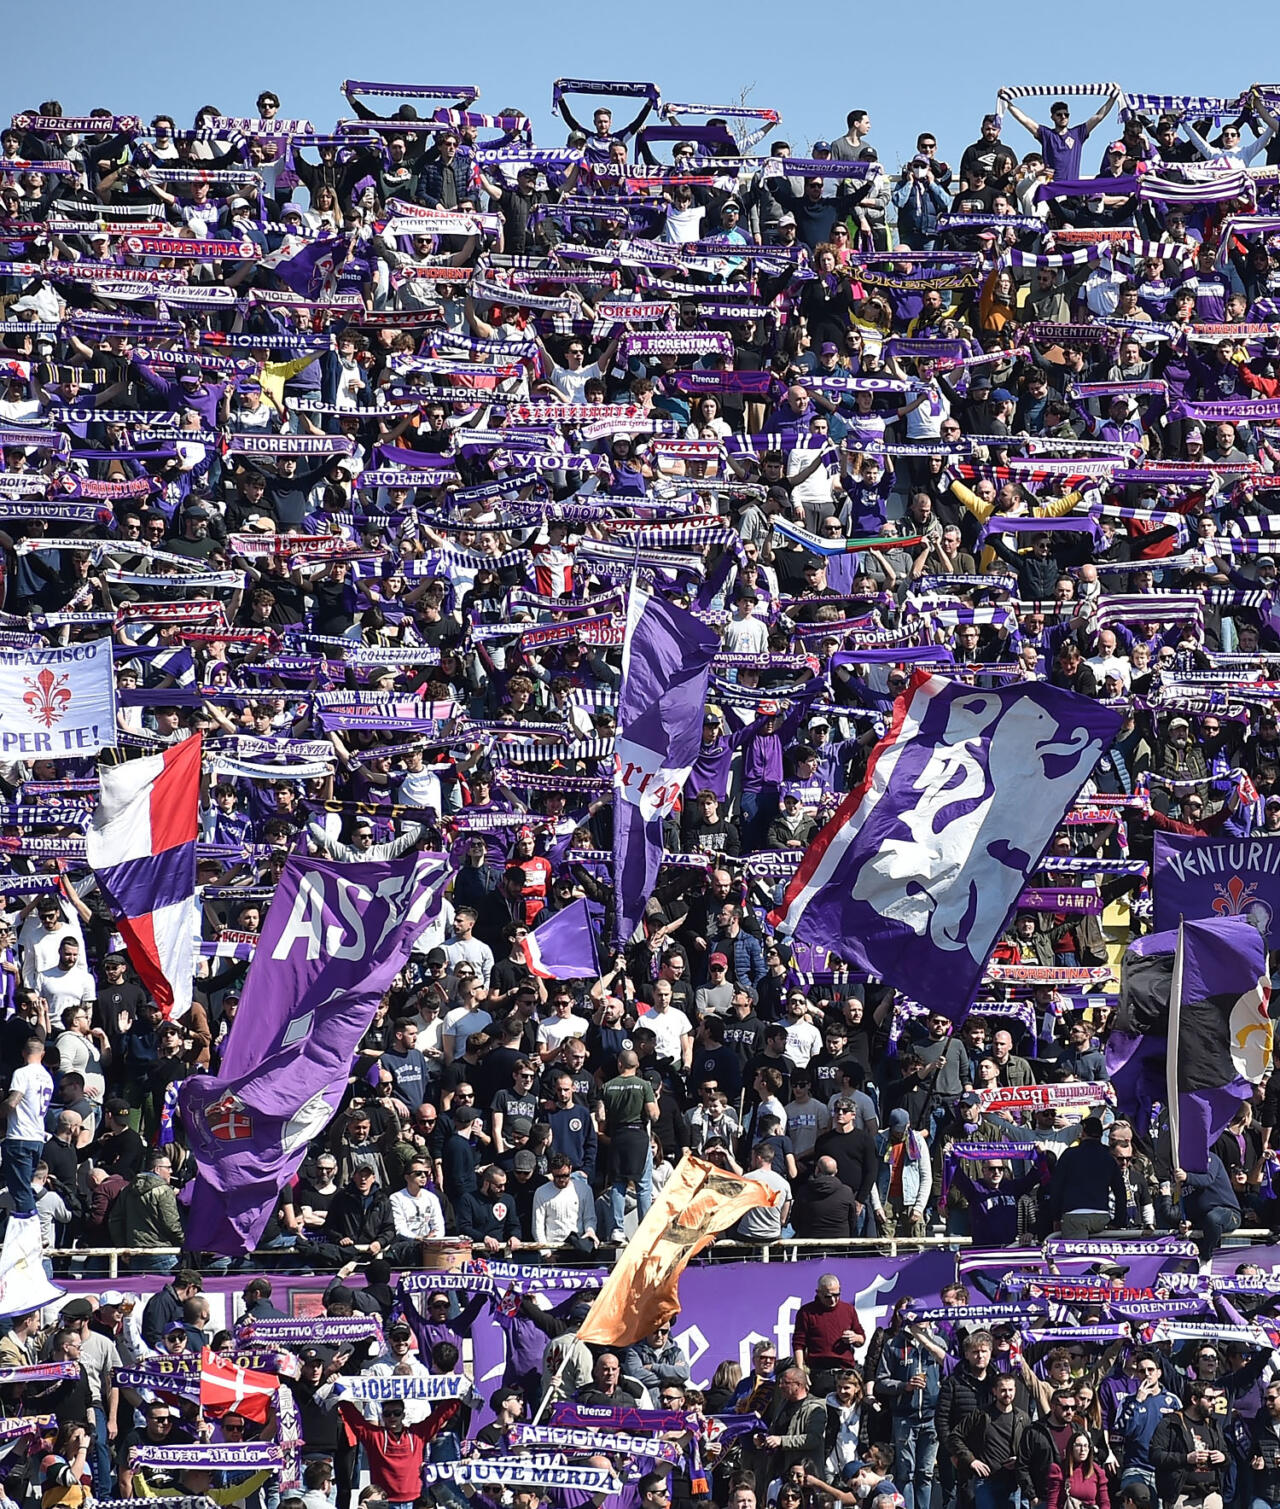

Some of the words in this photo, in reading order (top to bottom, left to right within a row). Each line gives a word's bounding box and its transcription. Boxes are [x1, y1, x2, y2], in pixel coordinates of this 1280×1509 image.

[558, 79, 648, 93] FIORENTINA
[1127, 92, 1220, 111] ULTRAS
[35, 116, 113, 130] FIORENTINA
[475, 147, 583, 164] COLLETTIVO
[972, 215, 1043, 230] FIORENTINA
[1057, 229, 1132, 244] FIORENTINA
[144, 239, 238, 257] FIORENTINA
[68, 266, 158, 282] FIORENTINA
[647, 276, 748, 294] FIORENTINA
[1034, 324, 1105, 338] FIORENTINA
[1193, 322, 1269, 335] FIORENTINA
[226, 334, 307, 348] FIORENTINA
[481, 339, 537, 358] FIESOLE
[631, 337, 643, 350] la
[647, 337, 719, 350] FIORENTINA
[151, 350, 236, 369] FIORENTINA
[691, 374, 720, 386] Firenze
[442, 387, 529, 403] FIORENTINA
[299, 397, 404, 413] FIORENTINA
[133, 429, 216, 444] FIORENTINA
[244, 436, 334, 452] FIORENTINA
[864, 442, 885, 454] ACF
[885, 443, 953, 455] FIORENTINA
[517, 451, 601, 471] VIOLA
[81, 480, 150, 496] FIORENTINA
[453, 472, 539, 500] FIORENTINA
[520, 617, 612, 650] FIORENTINA
[359, 650, 430, 663] COLLETTIVO
[1173, 670, 1249, 682] FIORENTINA
[348, 716, 413, 728] FIORENTINA
[1, 730, 54, 753] PER
[58, 725, 99, 749] TE!
[1056, 892, 1100, 909] CAMPI
[1002, 966, 1091, 980] FIORENTINA
[981, 1083, 1047, 1107] Bayern
[1046, 1240, 1061, 1256] 7
[1065, 1240, 1160, 1256] FEBBRAIO
[489, 1260, 520, 1278] CIAO
[1043, 1286, 1156, 1302] FIORENTINA
[921, 1307, 943, 1318] ACF
[941, 1303, 1022, 1318] FIORENTINA
[1119, 1298, 1200, 1314] FIORENTINA
[255, 1325, 312, 1339] COLLETTIVO
[324, 1323, 377, 1337] AUTONOMO
[116, 1371, 179, 1387] CURVA
[352, 1379, 459, 1400] FIORENTINA
[576, 1404, 613, 1418] Firenze
[520, 1427, 663, 1456] AFICIONADOS
[143, 1442, 204, 1463] Forza
[208, 1446, 261, 1464] Viola
[462, 1463, 527, 1482] JUVE
[530, 1467, 617, 1492] MERDA
